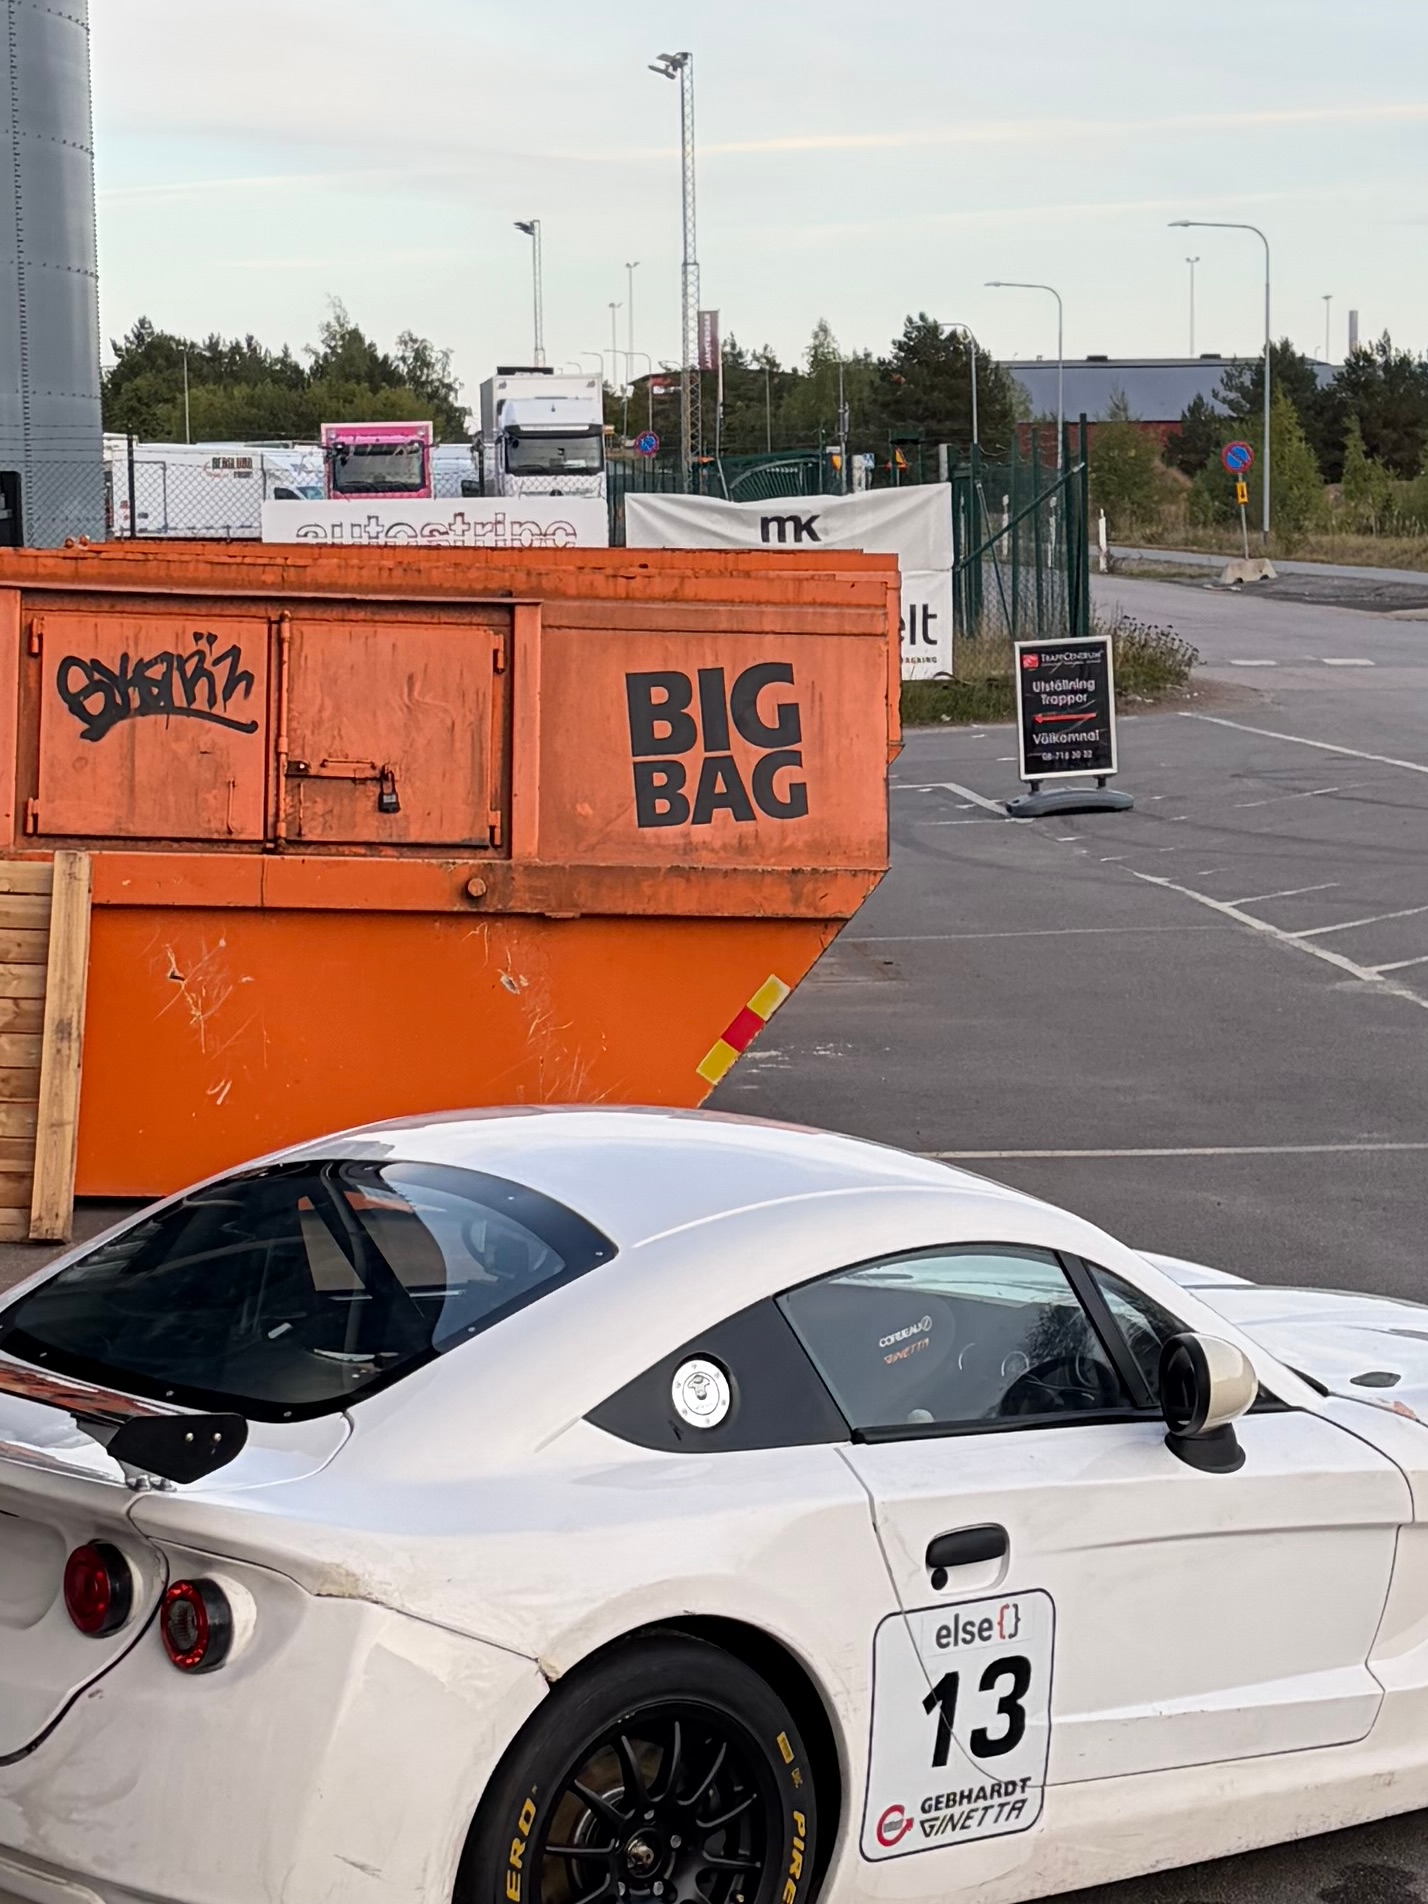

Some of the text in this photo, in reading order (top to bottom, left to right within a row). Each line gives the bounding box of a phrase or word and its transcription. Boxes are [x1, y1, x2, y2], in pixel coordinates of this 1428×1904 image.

[761, 504, 821, 544] mk
[1032, 678, 1096, 693] Utställning
[1040, 693, 1088, 707] Trappor
[625, 662, 802, 757] BIG
[632, 749, 809, 828] BAG
[922, 1655, 1032, 1768] 13
[921, 1776, 1031, 1814] GEBHARDT
[920, 1798, 1028, 1838] GINETTA
